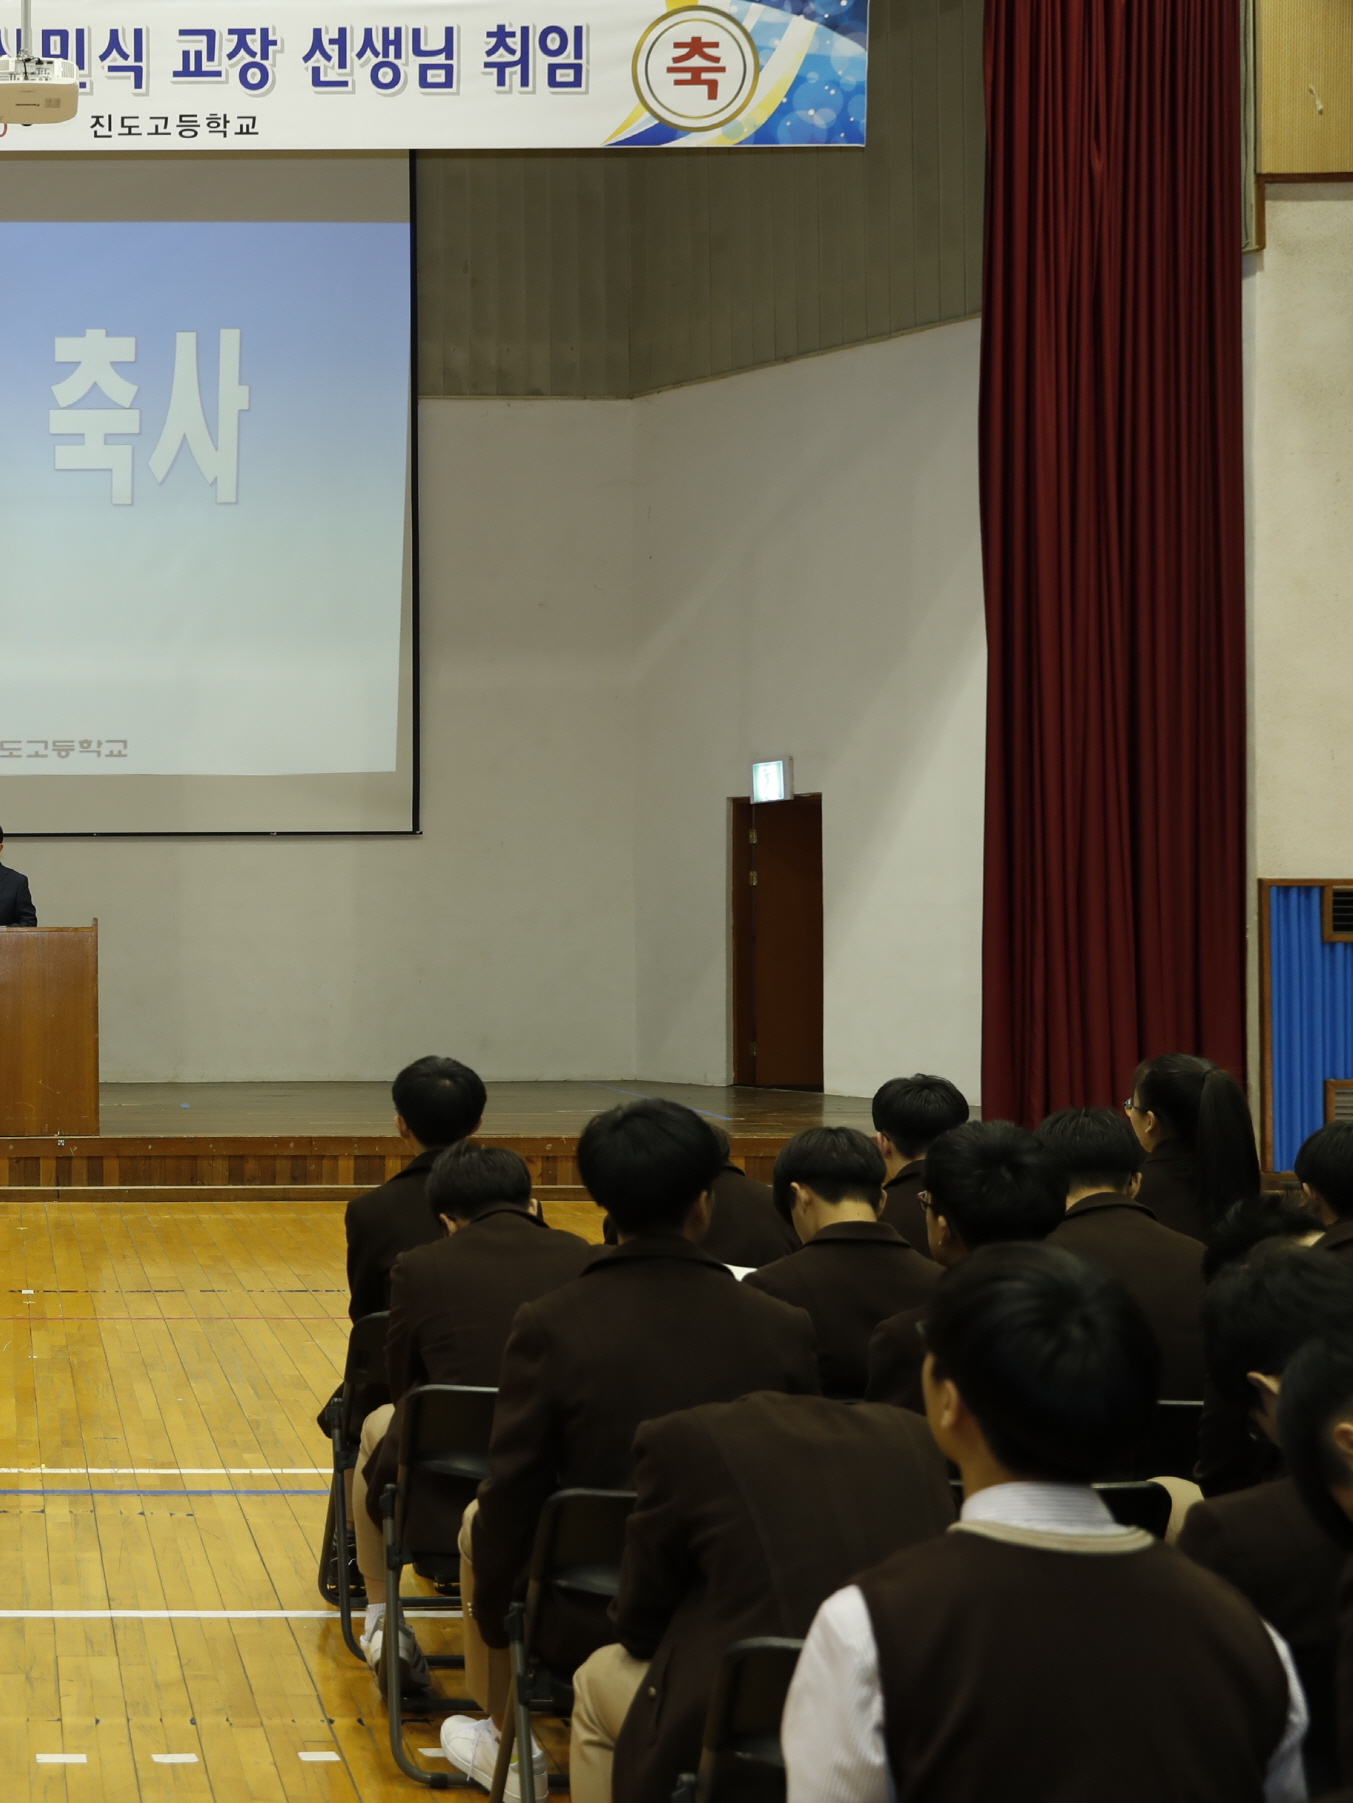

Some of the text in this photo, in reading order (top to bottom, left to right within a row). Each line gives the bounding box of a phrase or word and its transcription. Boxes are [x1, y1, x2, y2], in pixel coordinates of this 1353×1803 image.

[174, 27, 277, 90] 교장
[303, 27, 453, 90] 선생님
[485, 24, 582, 88] 취임
[666, 36, 727, 101] 축
[90, 113, 259, 139] 진도고등학교
[48, 328, 250, 506] 축사
